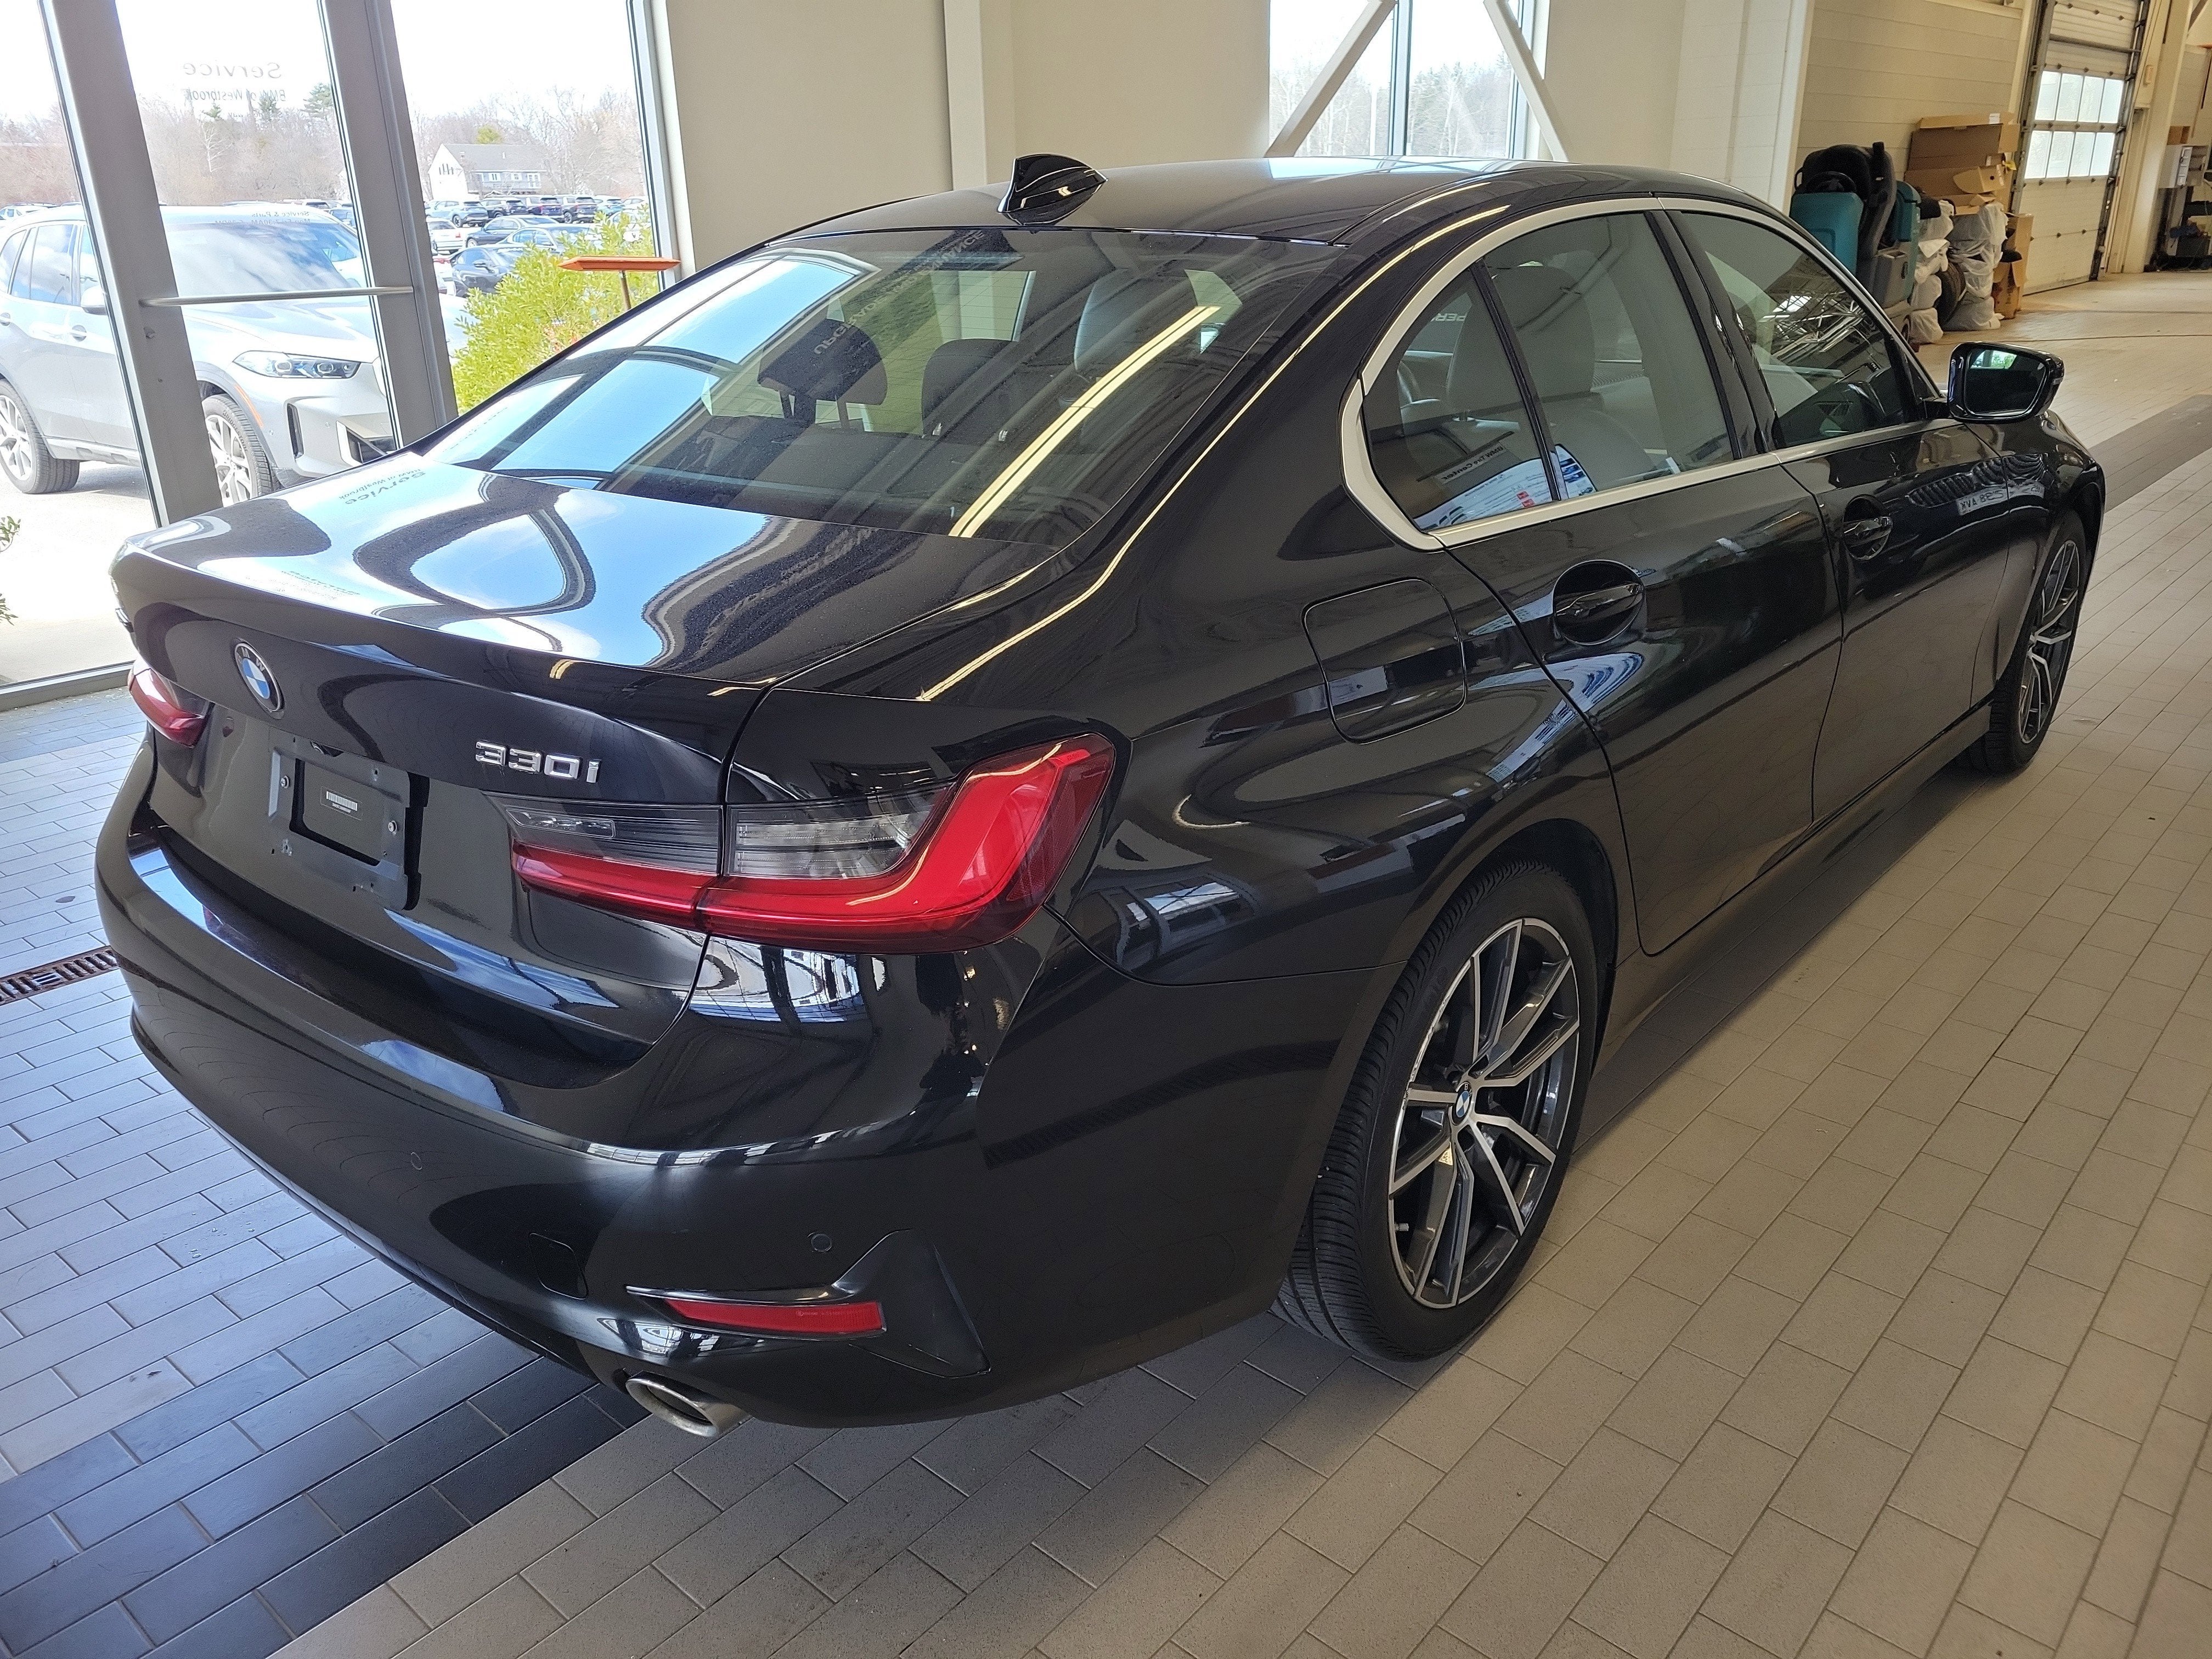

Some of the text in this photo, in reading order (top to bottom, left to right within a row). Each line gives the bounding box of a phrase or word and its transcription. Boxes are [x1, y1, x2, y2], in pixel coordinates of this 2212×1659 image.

[1430, 312, 1468, 322] PER
[236, 646, 266, 672] BMW
[475, 741, 599, 783] 330i
